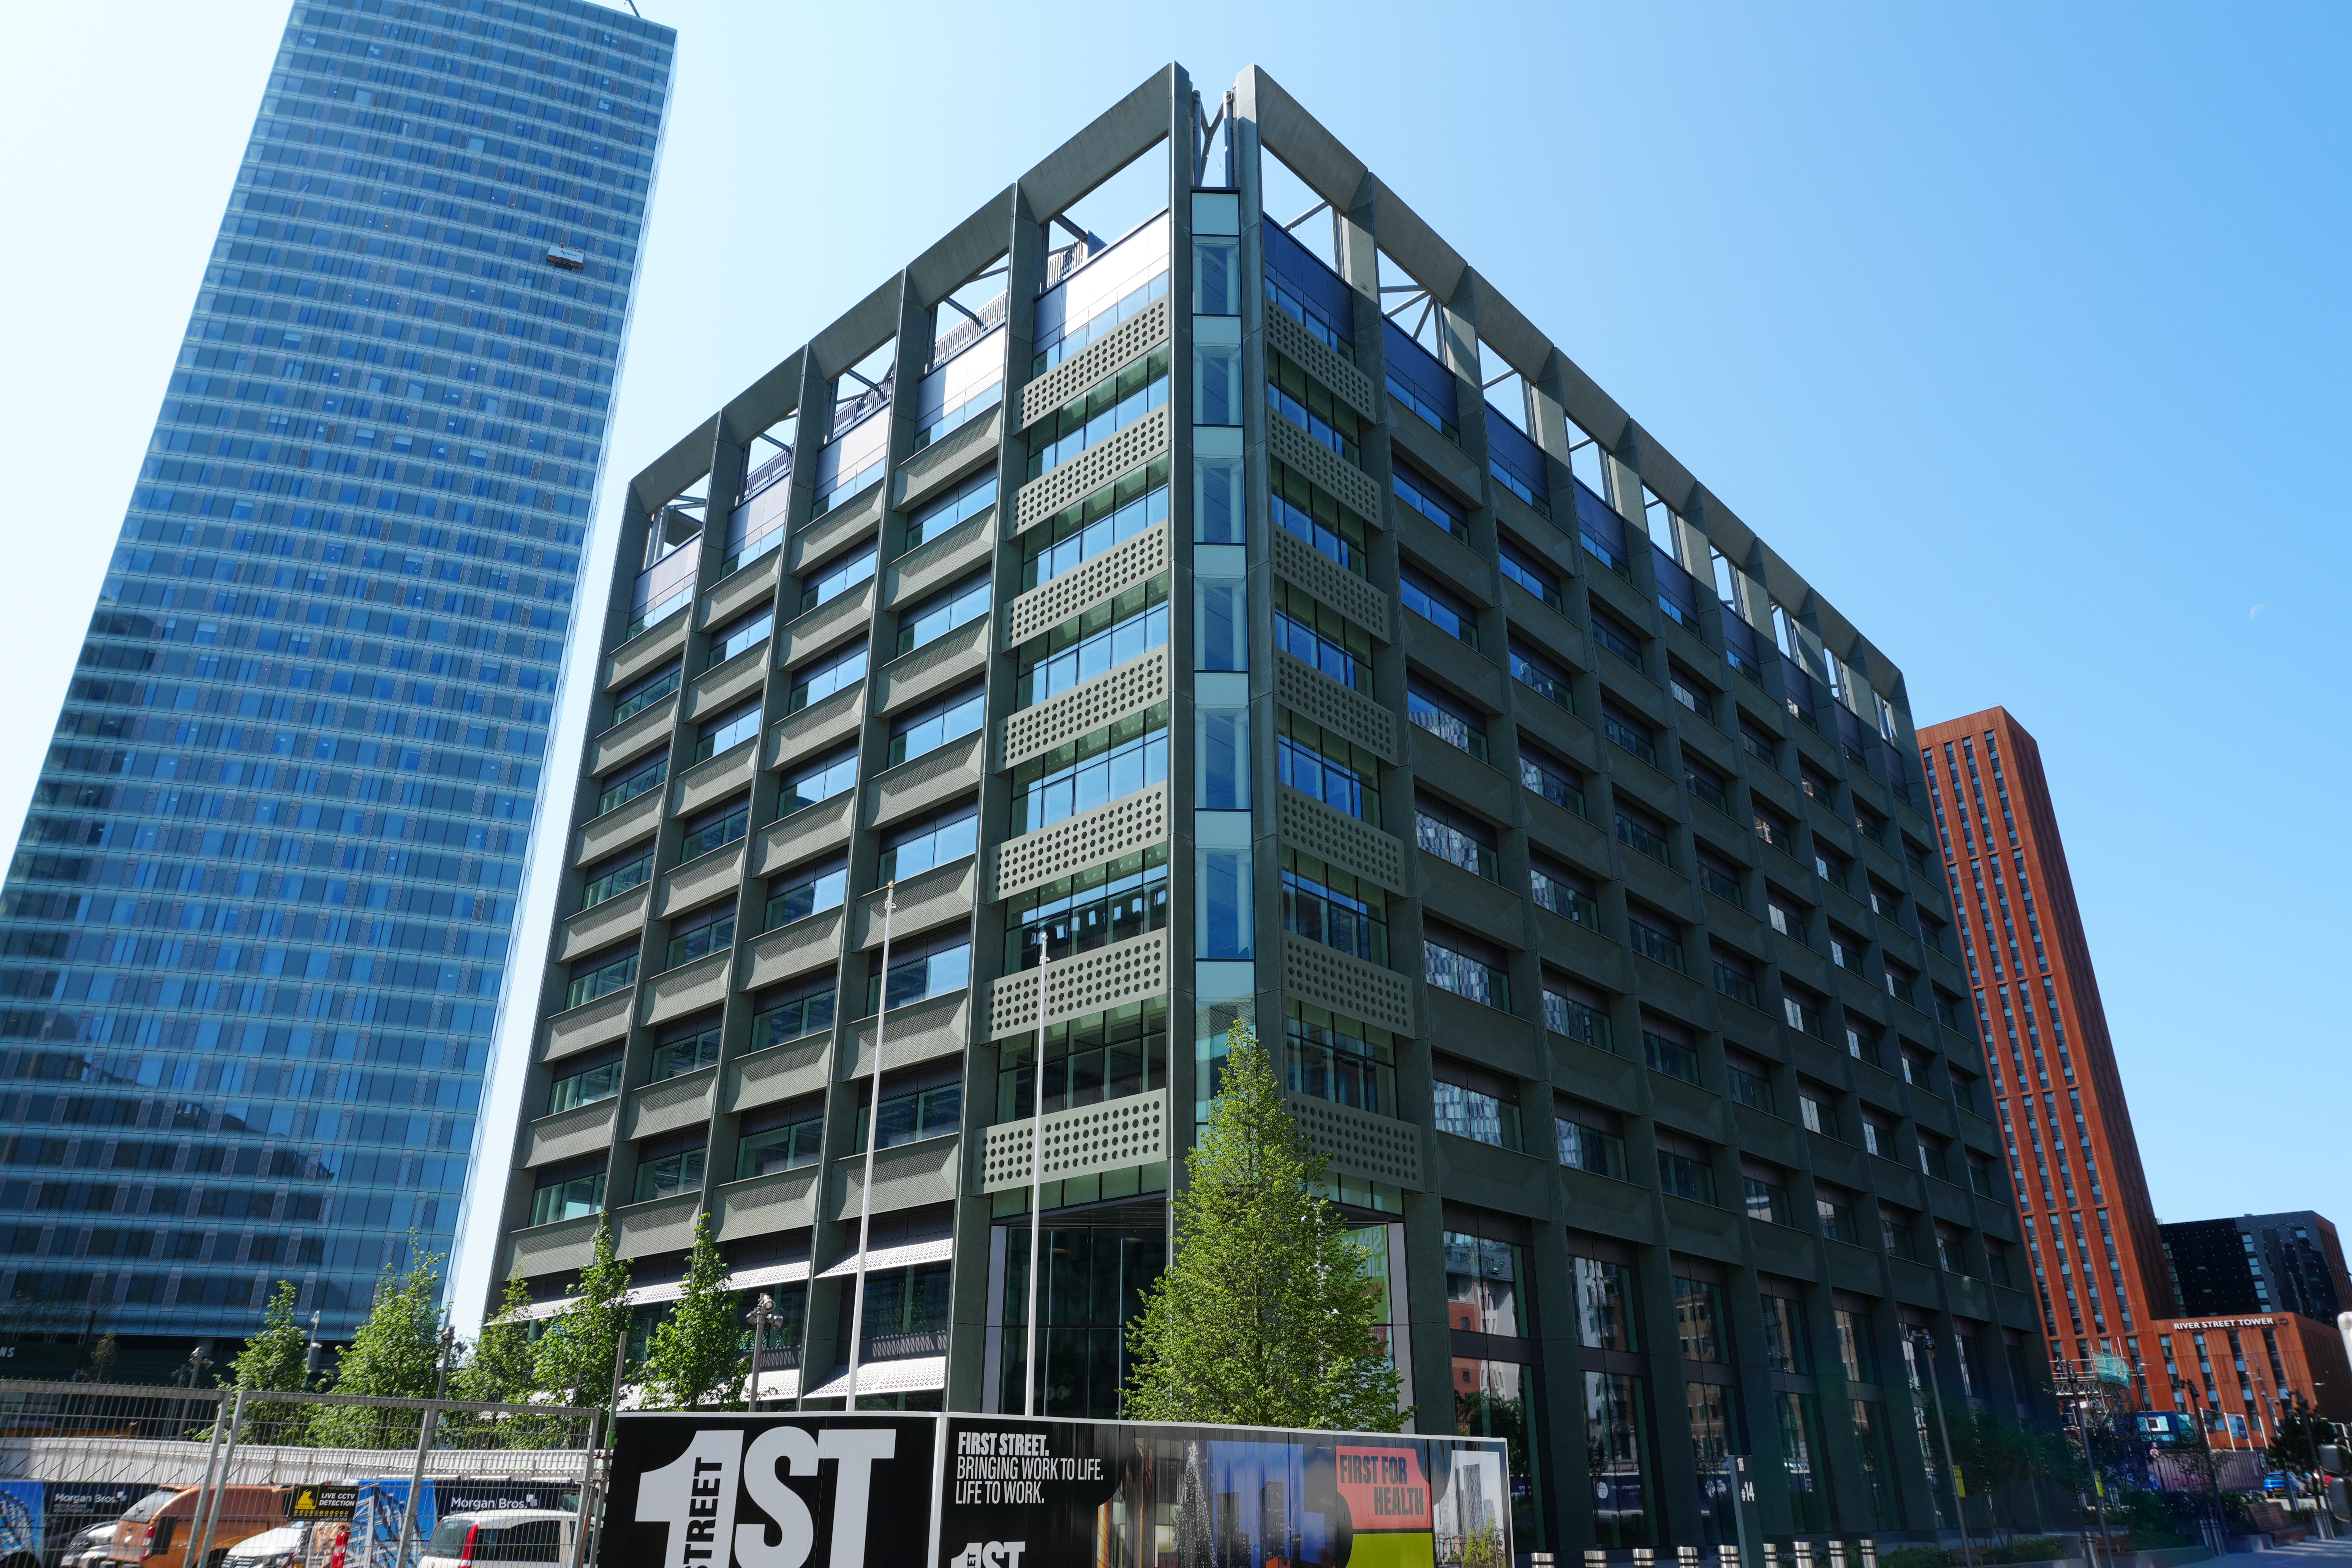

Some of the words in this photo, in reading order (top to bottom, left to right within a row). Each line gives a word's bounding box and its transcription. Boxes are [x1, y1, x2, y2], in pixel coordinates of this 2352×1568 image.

[958, 1432, 997, 1455] FIRST
[999, 1433, 1050, 1456] STREET.
[957, 1456, 1018, 1480] BRINGING
[1022, 1457, 1059, 1480] WORK
[1061, 1458, 1075, 1480] TO
[1078, 1458, 1103, 1480] LIFE.
[1340, 1455, 1378, 1484] FIRST
[1381, 1456, 1408, 1484] FOR
[55, 1492, 93, 1503] Morgan
[634, 1426, 896, 1568] 1ST
[955, 1481, 982, 1504] LIFE
[985, 1481, 1001, 1504] TO
[1004, 1481, 1045, 1504] WORK.
[1374, 1487, 1424, 1515] HEALTH
[1741, 1481, 1755, 1501] #14
[451, 1497, 495, 1510] Morgan
[499, 1498, 527, 1509] Bros.
[683, 1457, 722, 1568] TREET
